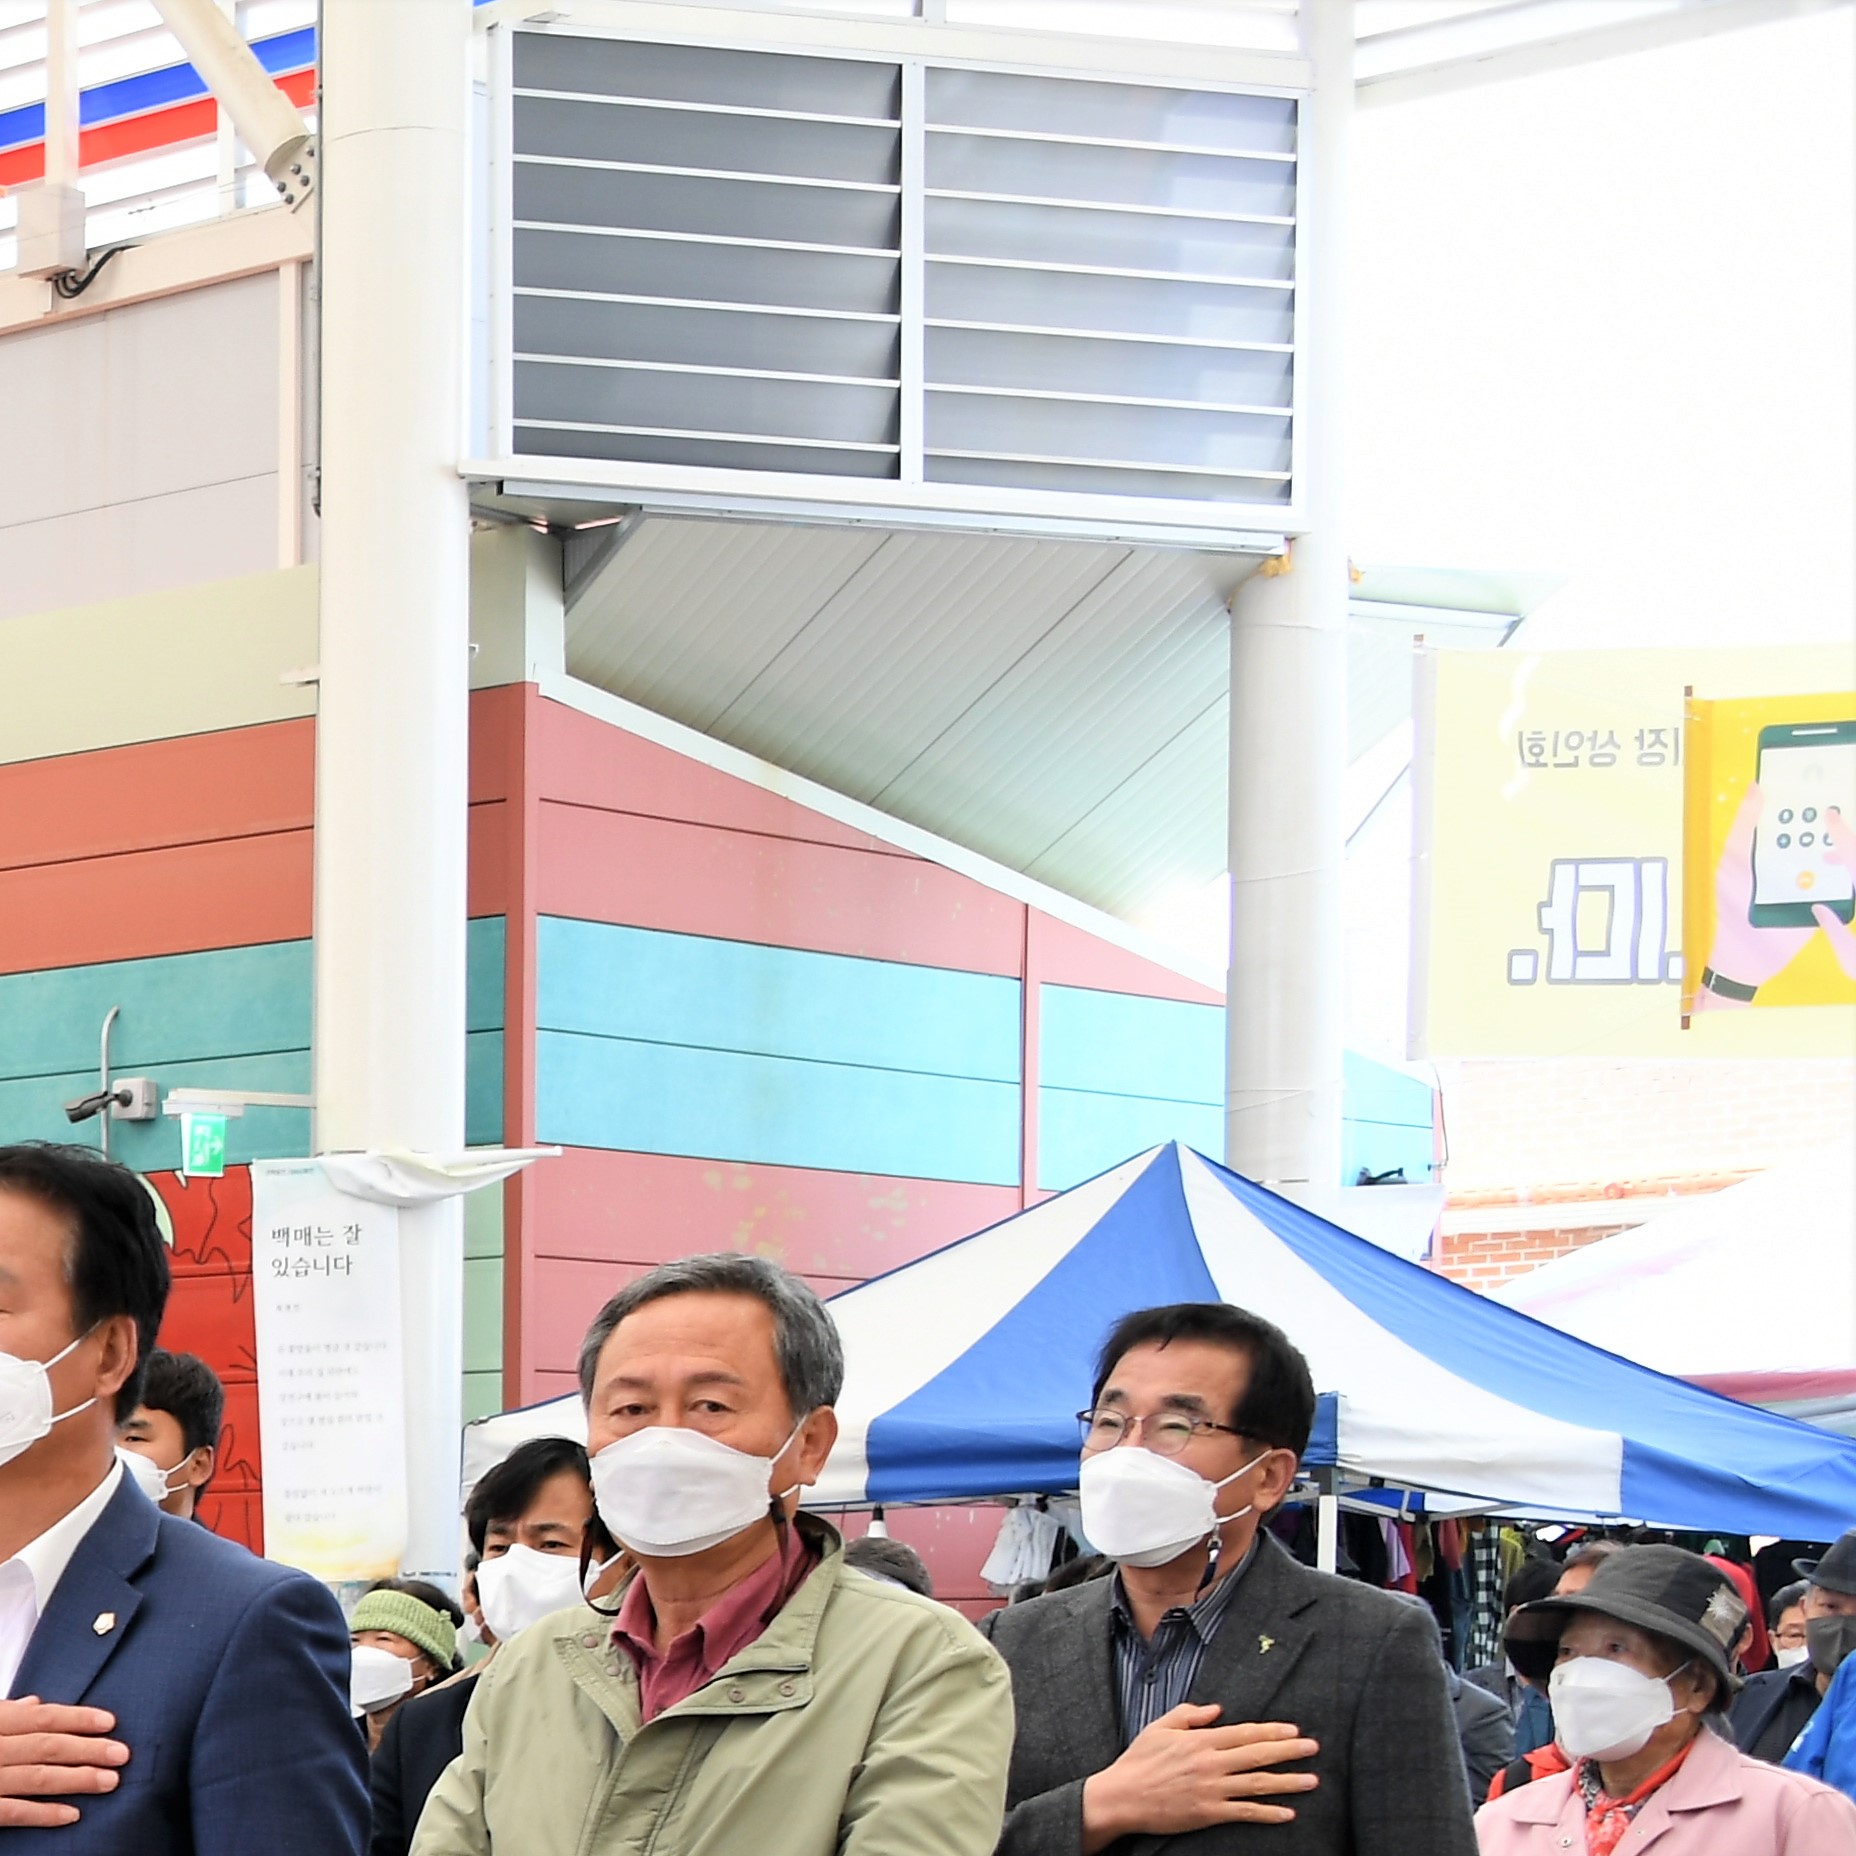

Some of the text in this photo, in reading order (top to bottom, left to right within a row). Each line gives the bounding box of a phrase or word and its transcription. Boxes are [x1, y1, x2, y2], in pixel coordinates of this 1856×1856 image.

[271, 1223, 363, 1248] 백매는 잘
[271, 1254, 354, 1278] 있습니다
